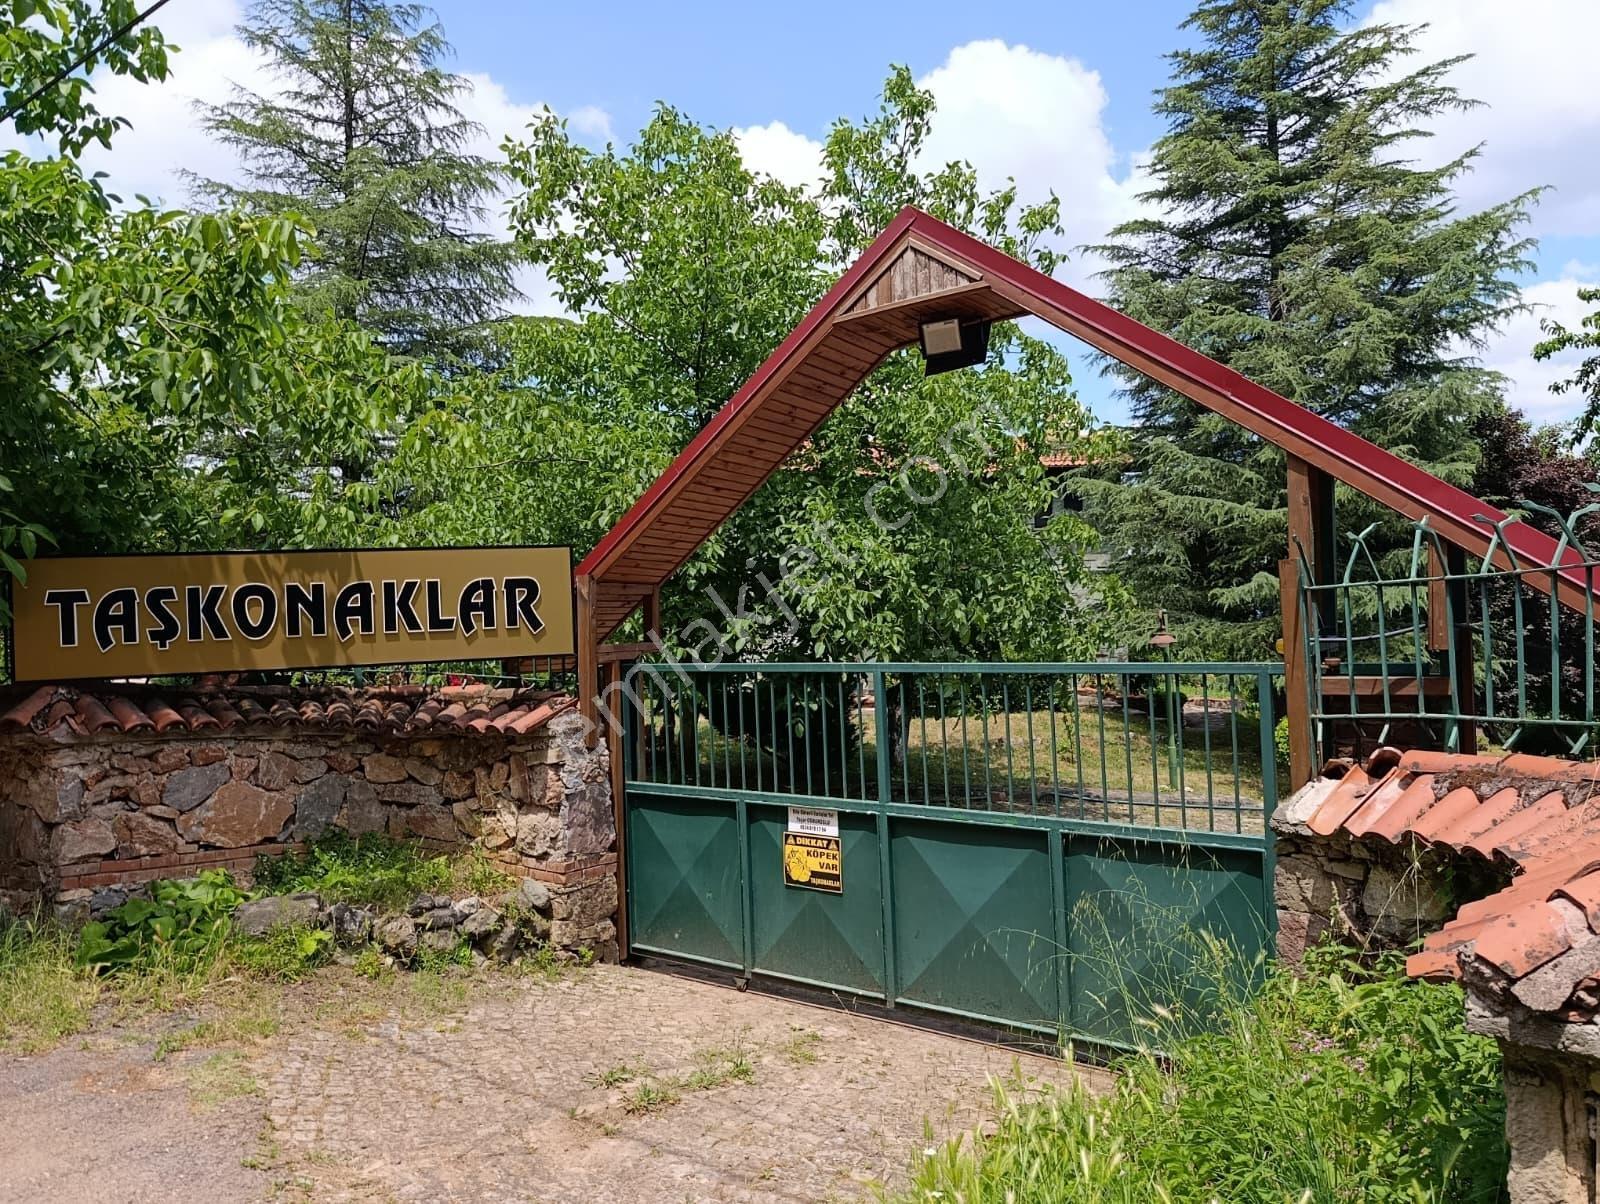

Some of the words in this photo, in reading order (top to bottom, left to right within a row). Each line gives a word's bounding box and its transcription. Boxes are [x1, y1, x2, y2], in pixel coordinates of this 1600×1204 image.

[45, 576, 545, 653] TAŞKONAKLAR
[806, 849, 838, 861] KÖPEK
[819, 862, 838, 872] VAR
